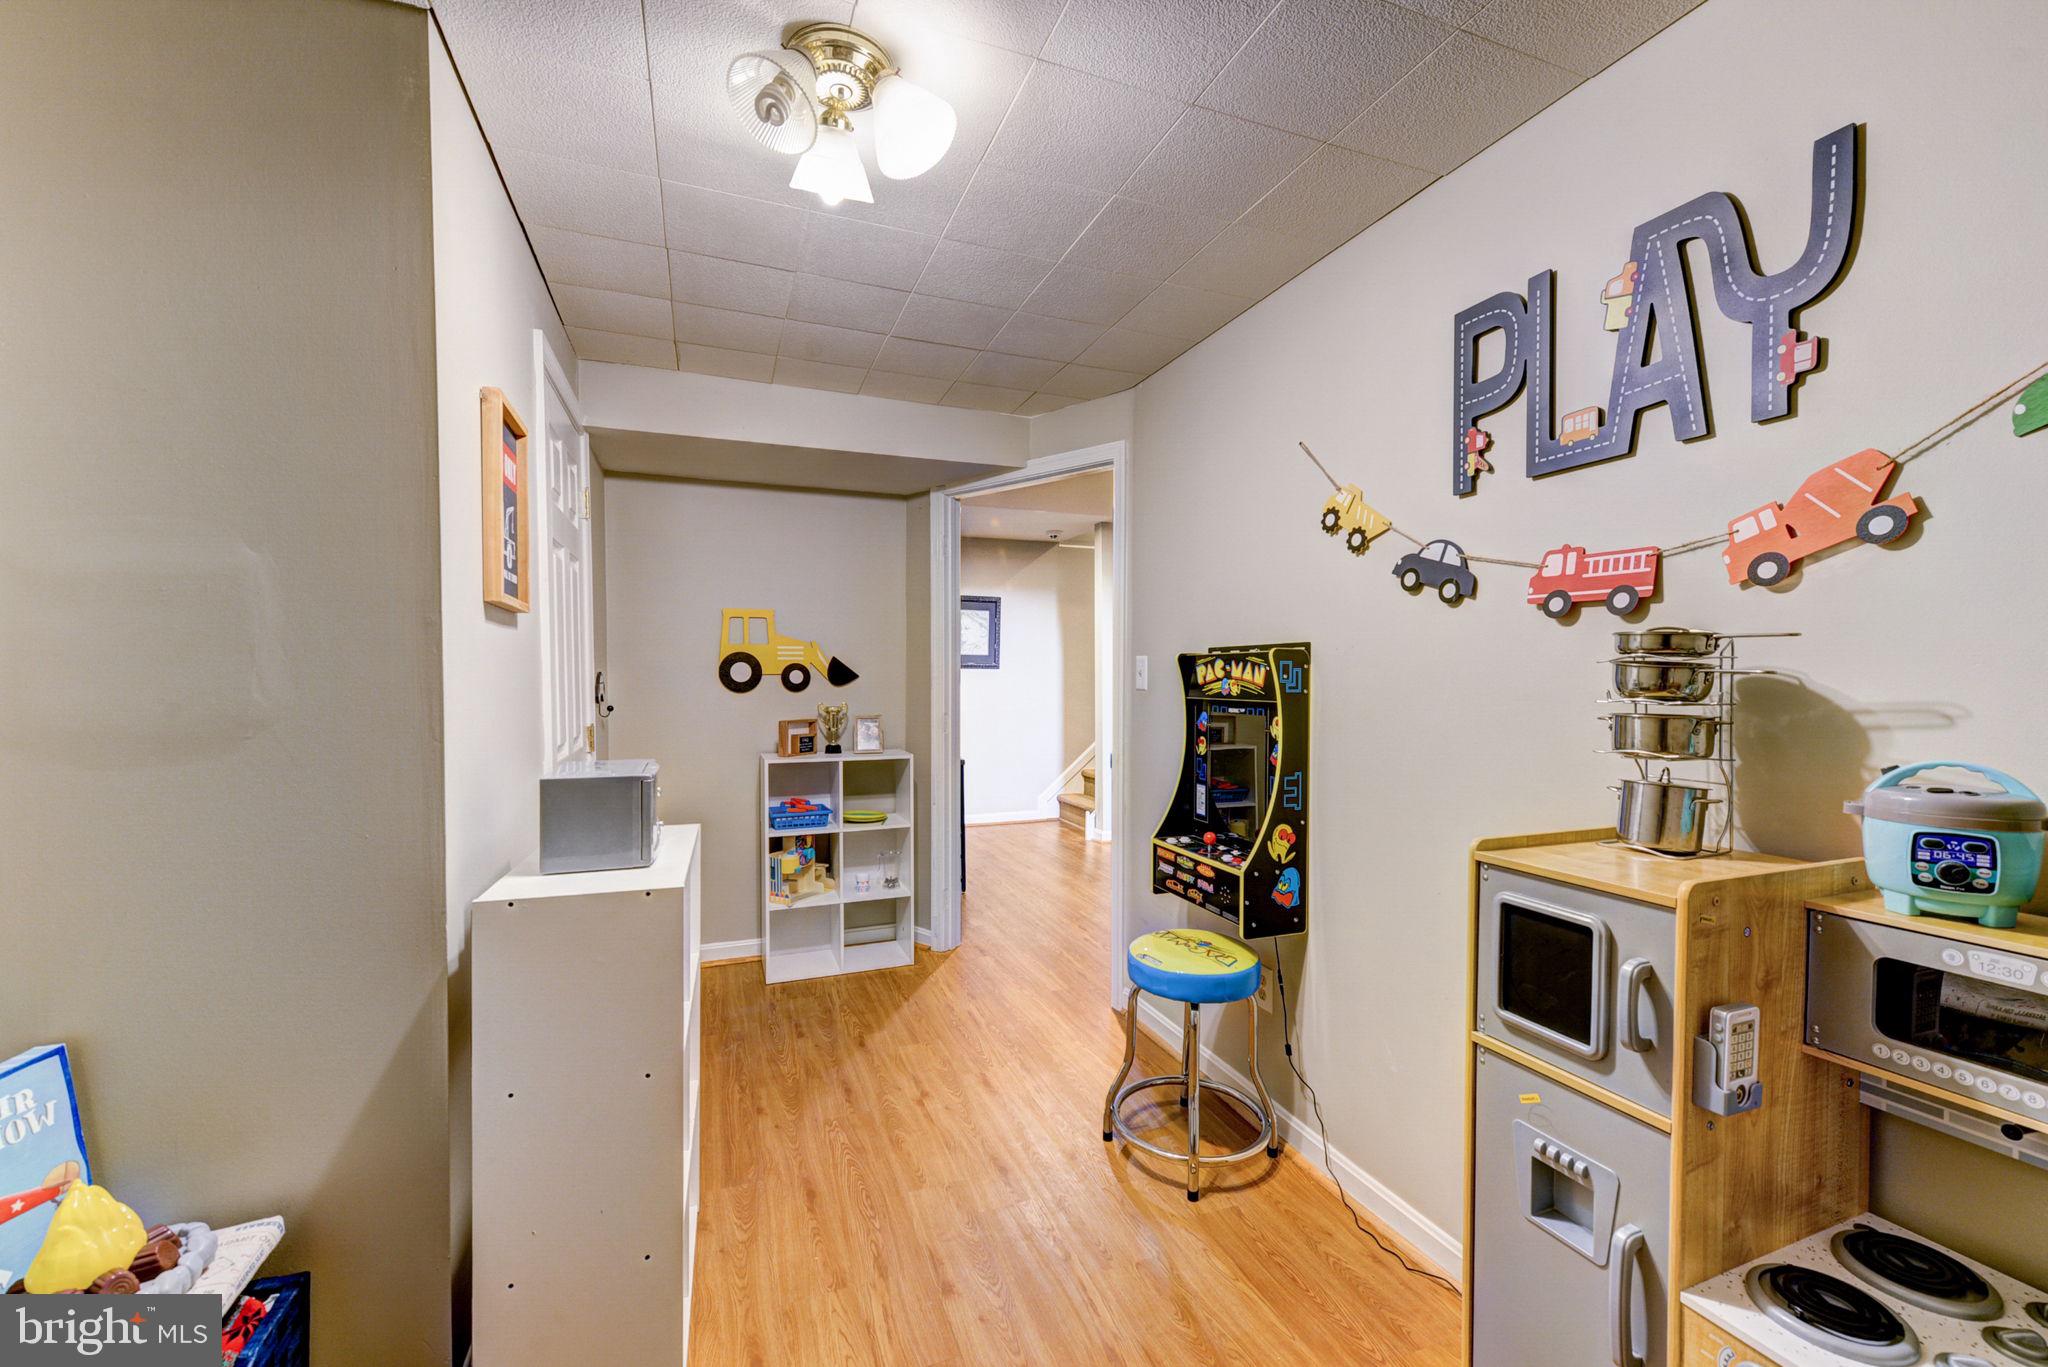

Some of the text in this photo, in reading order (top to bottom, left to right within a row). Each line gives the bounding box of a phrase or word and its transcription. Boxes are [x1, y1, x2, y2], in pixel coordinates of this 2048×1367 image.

[1454, 122, 1860, 496] PLAY
[1196, 658, 1266, 689] PAC-MAN
[1980, 961, 2024, 981] 12:30
[0, 1100, 57, 1150] OW
